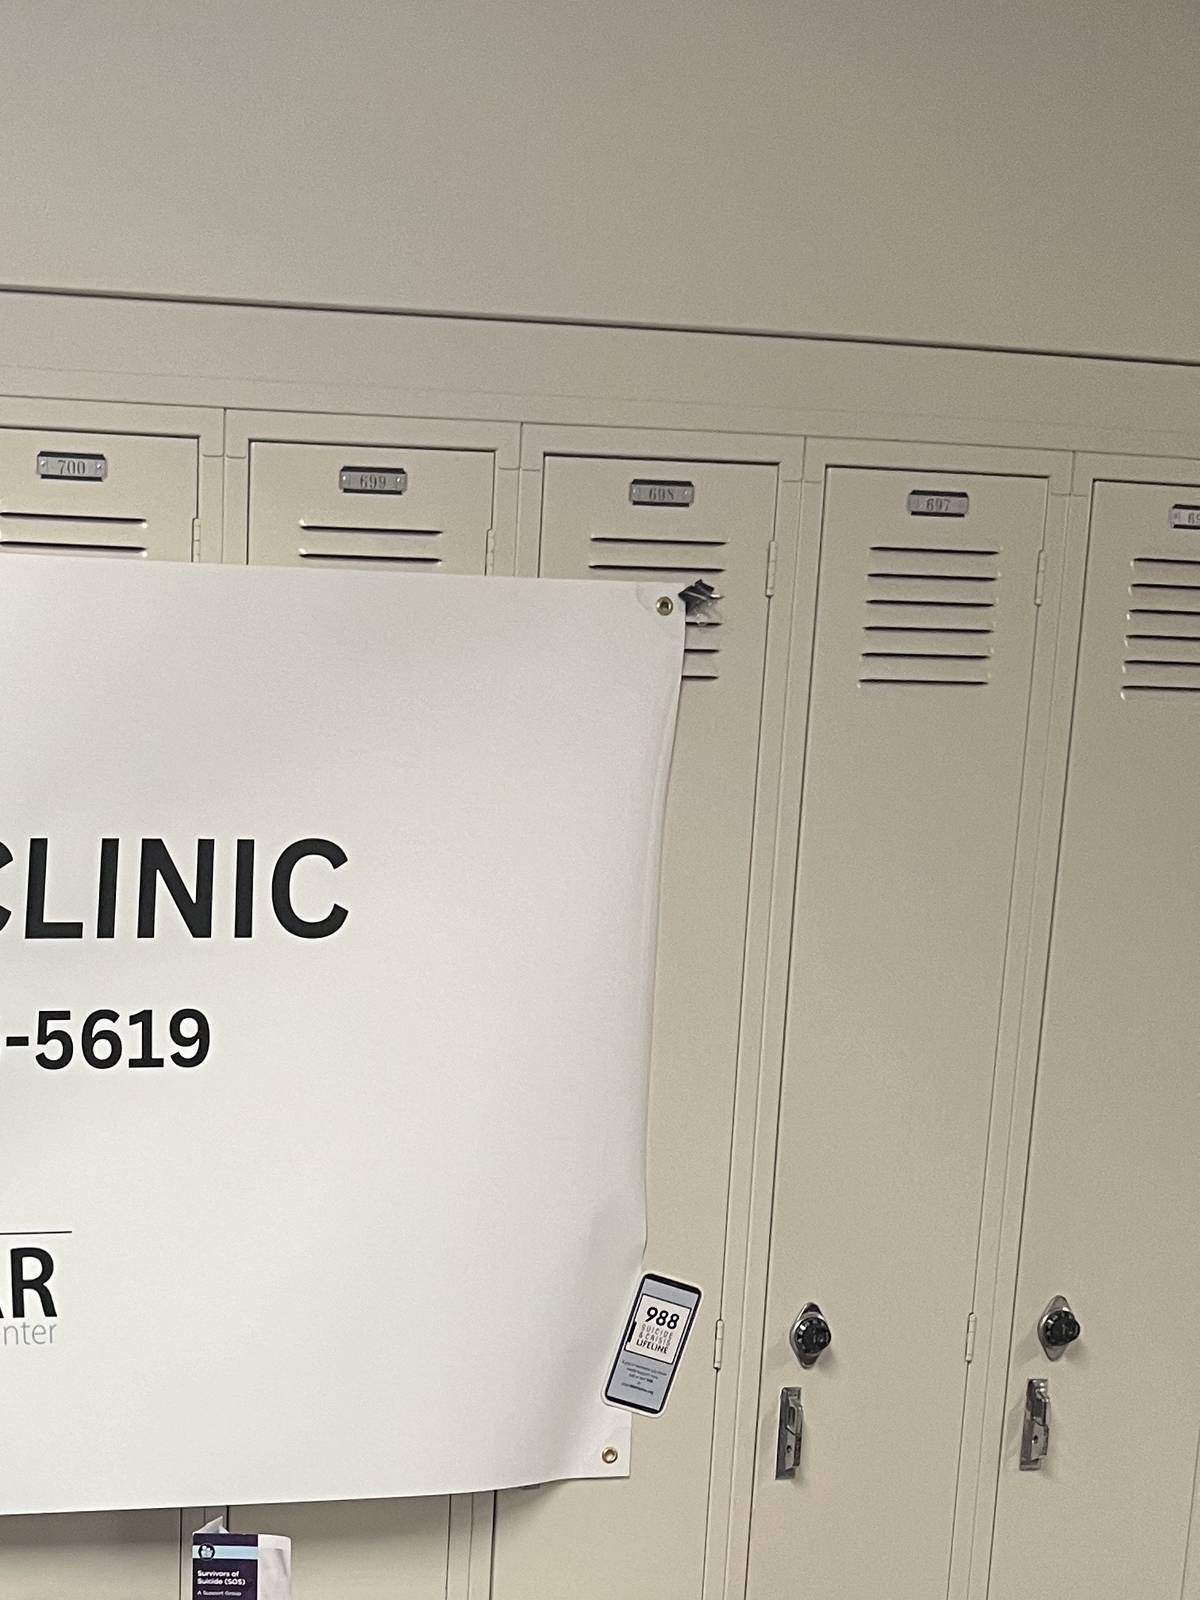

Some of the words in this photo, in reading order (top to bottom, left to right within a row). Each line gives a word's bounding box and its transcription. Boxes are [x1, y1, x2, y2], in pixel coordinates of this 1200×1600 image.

[57, 459, 86, 475] 700
[645, 1306, 680, 1330] 988
[636, 1339, 669, 1354] LIFELINE
